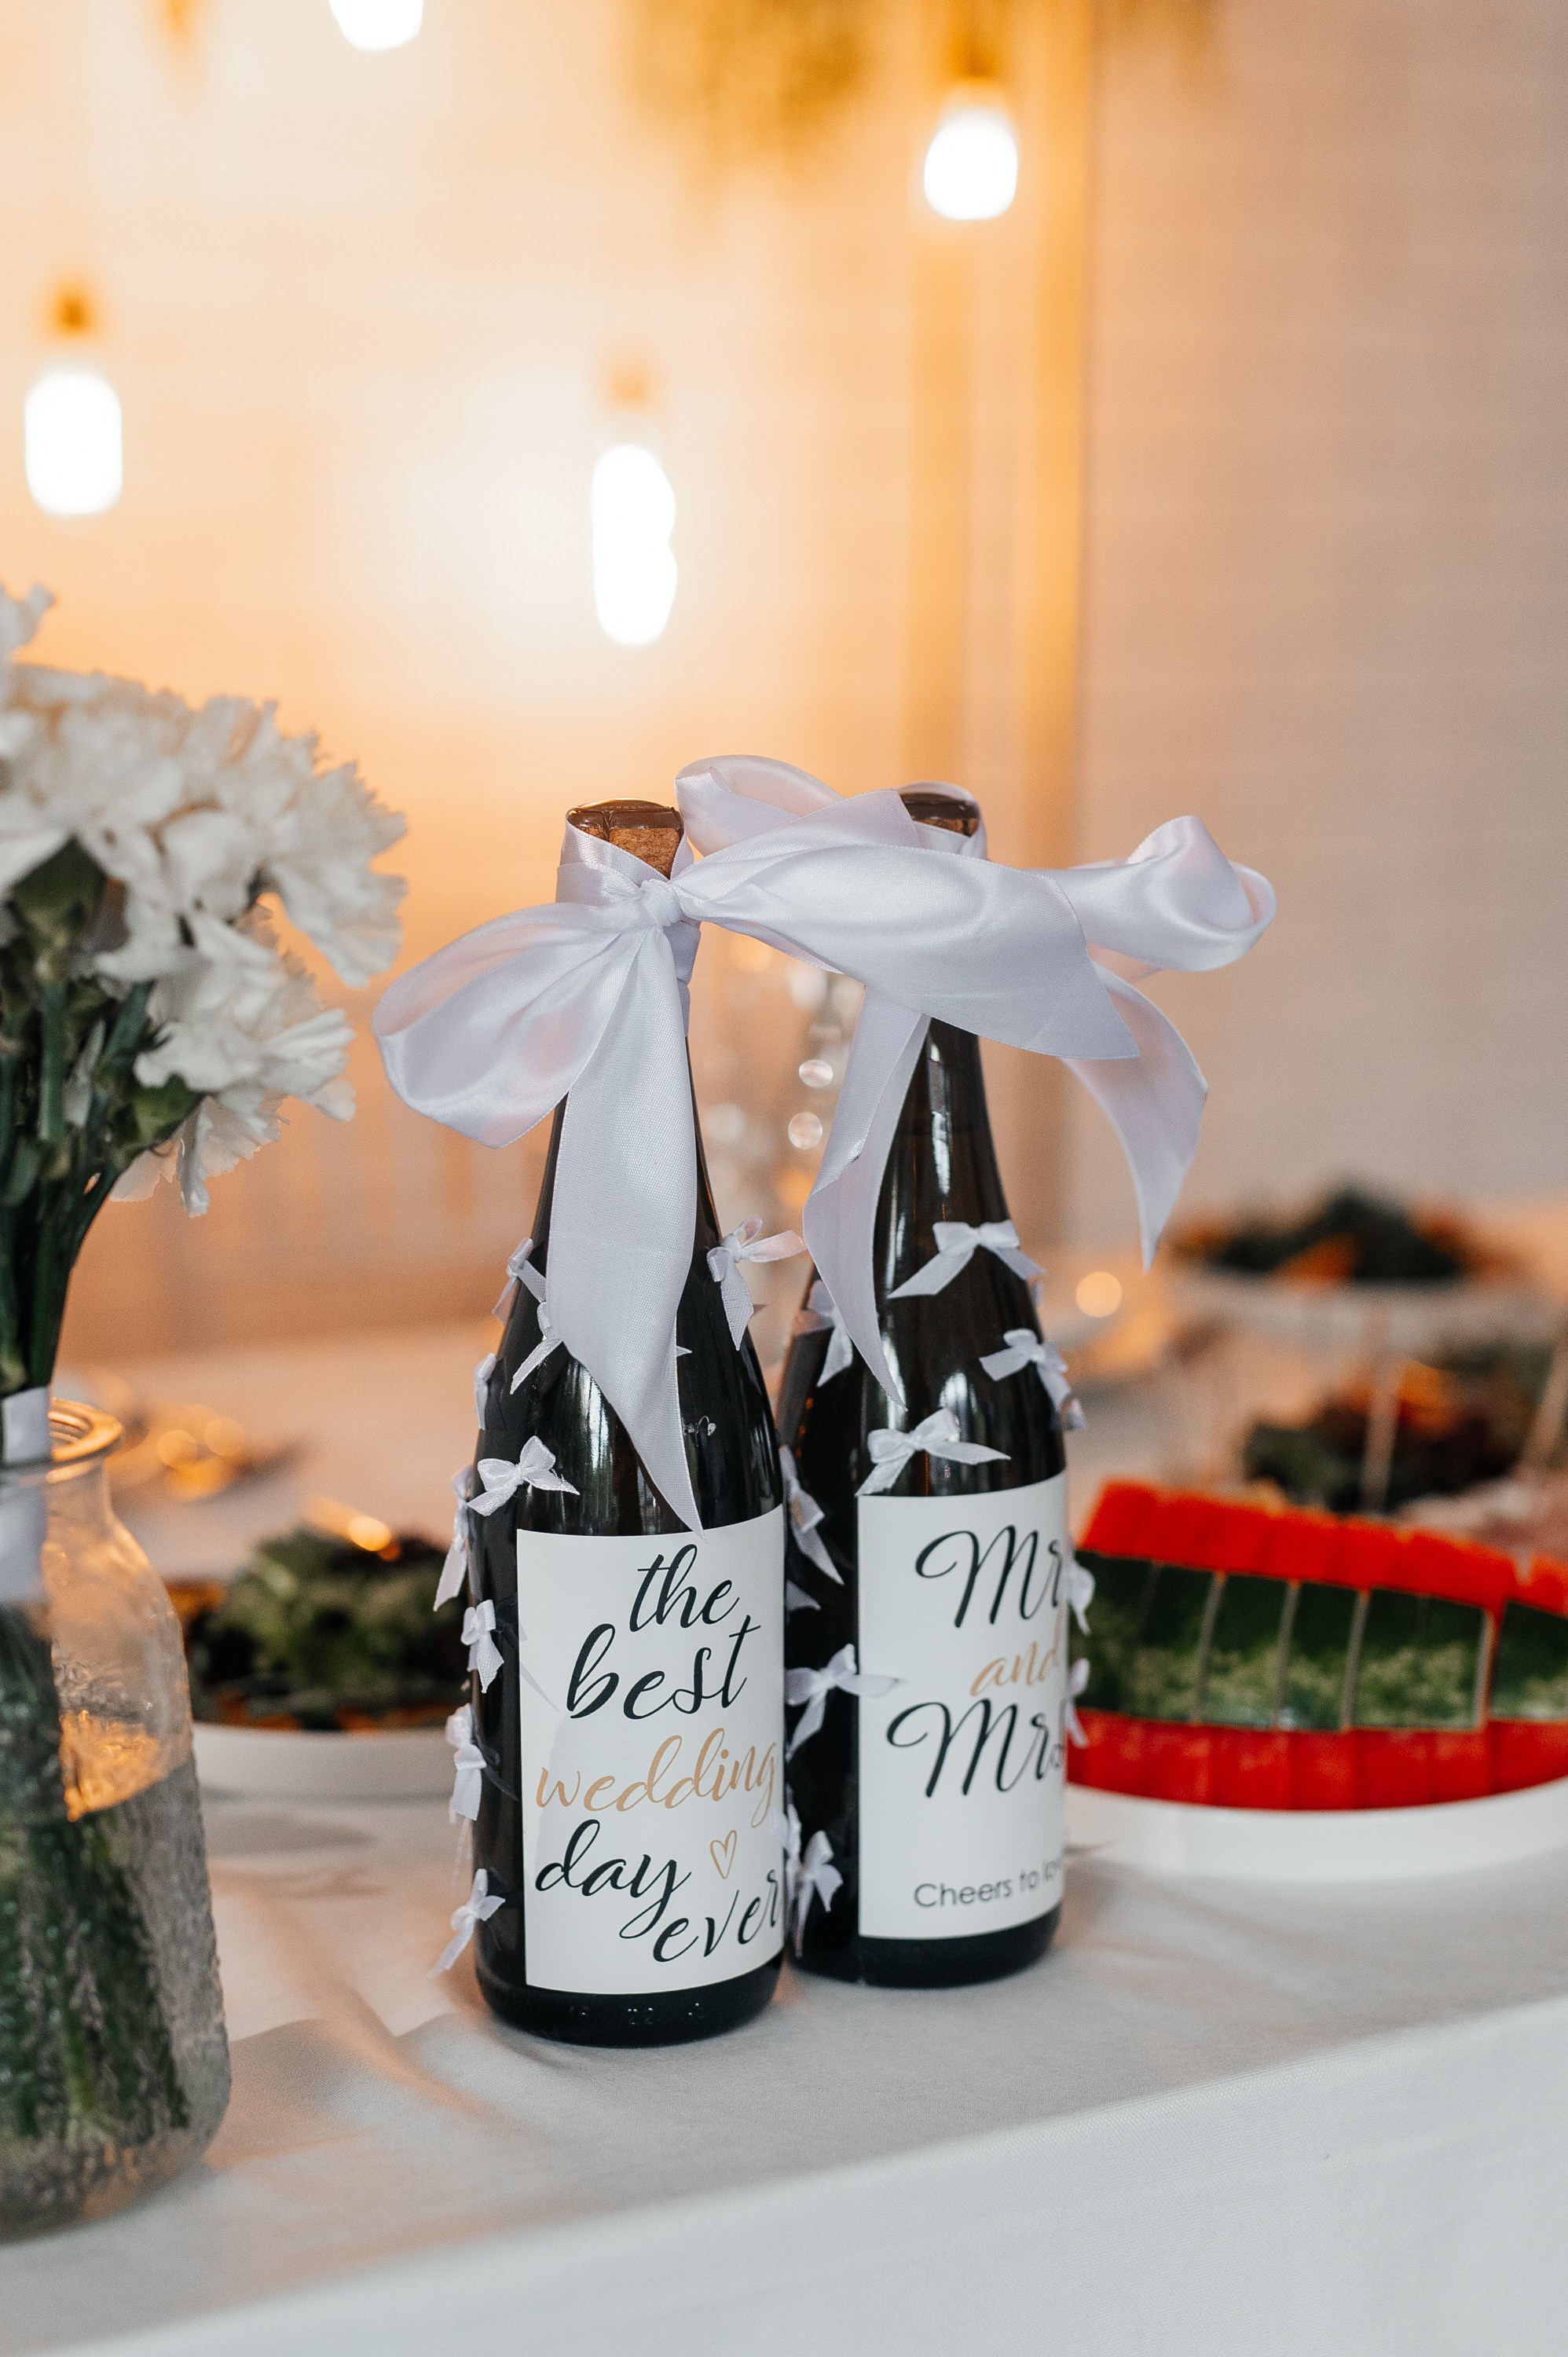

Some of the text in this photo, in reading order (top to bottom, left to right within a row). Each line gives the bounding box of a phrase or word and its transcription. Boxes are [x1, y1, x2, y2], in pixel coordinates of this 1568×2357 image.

[629, 1544, 740, 1633] the
[566, 1615, 761, 1720] best
[970, 1600, 1066, 1697] and
[536, 1728, 776, 1828] wedding
[534, 1819, 692, 1940] day
[653, 1868, 779, 1963] ever
[914, 1878, 1013, 1908] Cheers
[1019, 1868, 1040, 1893] to
